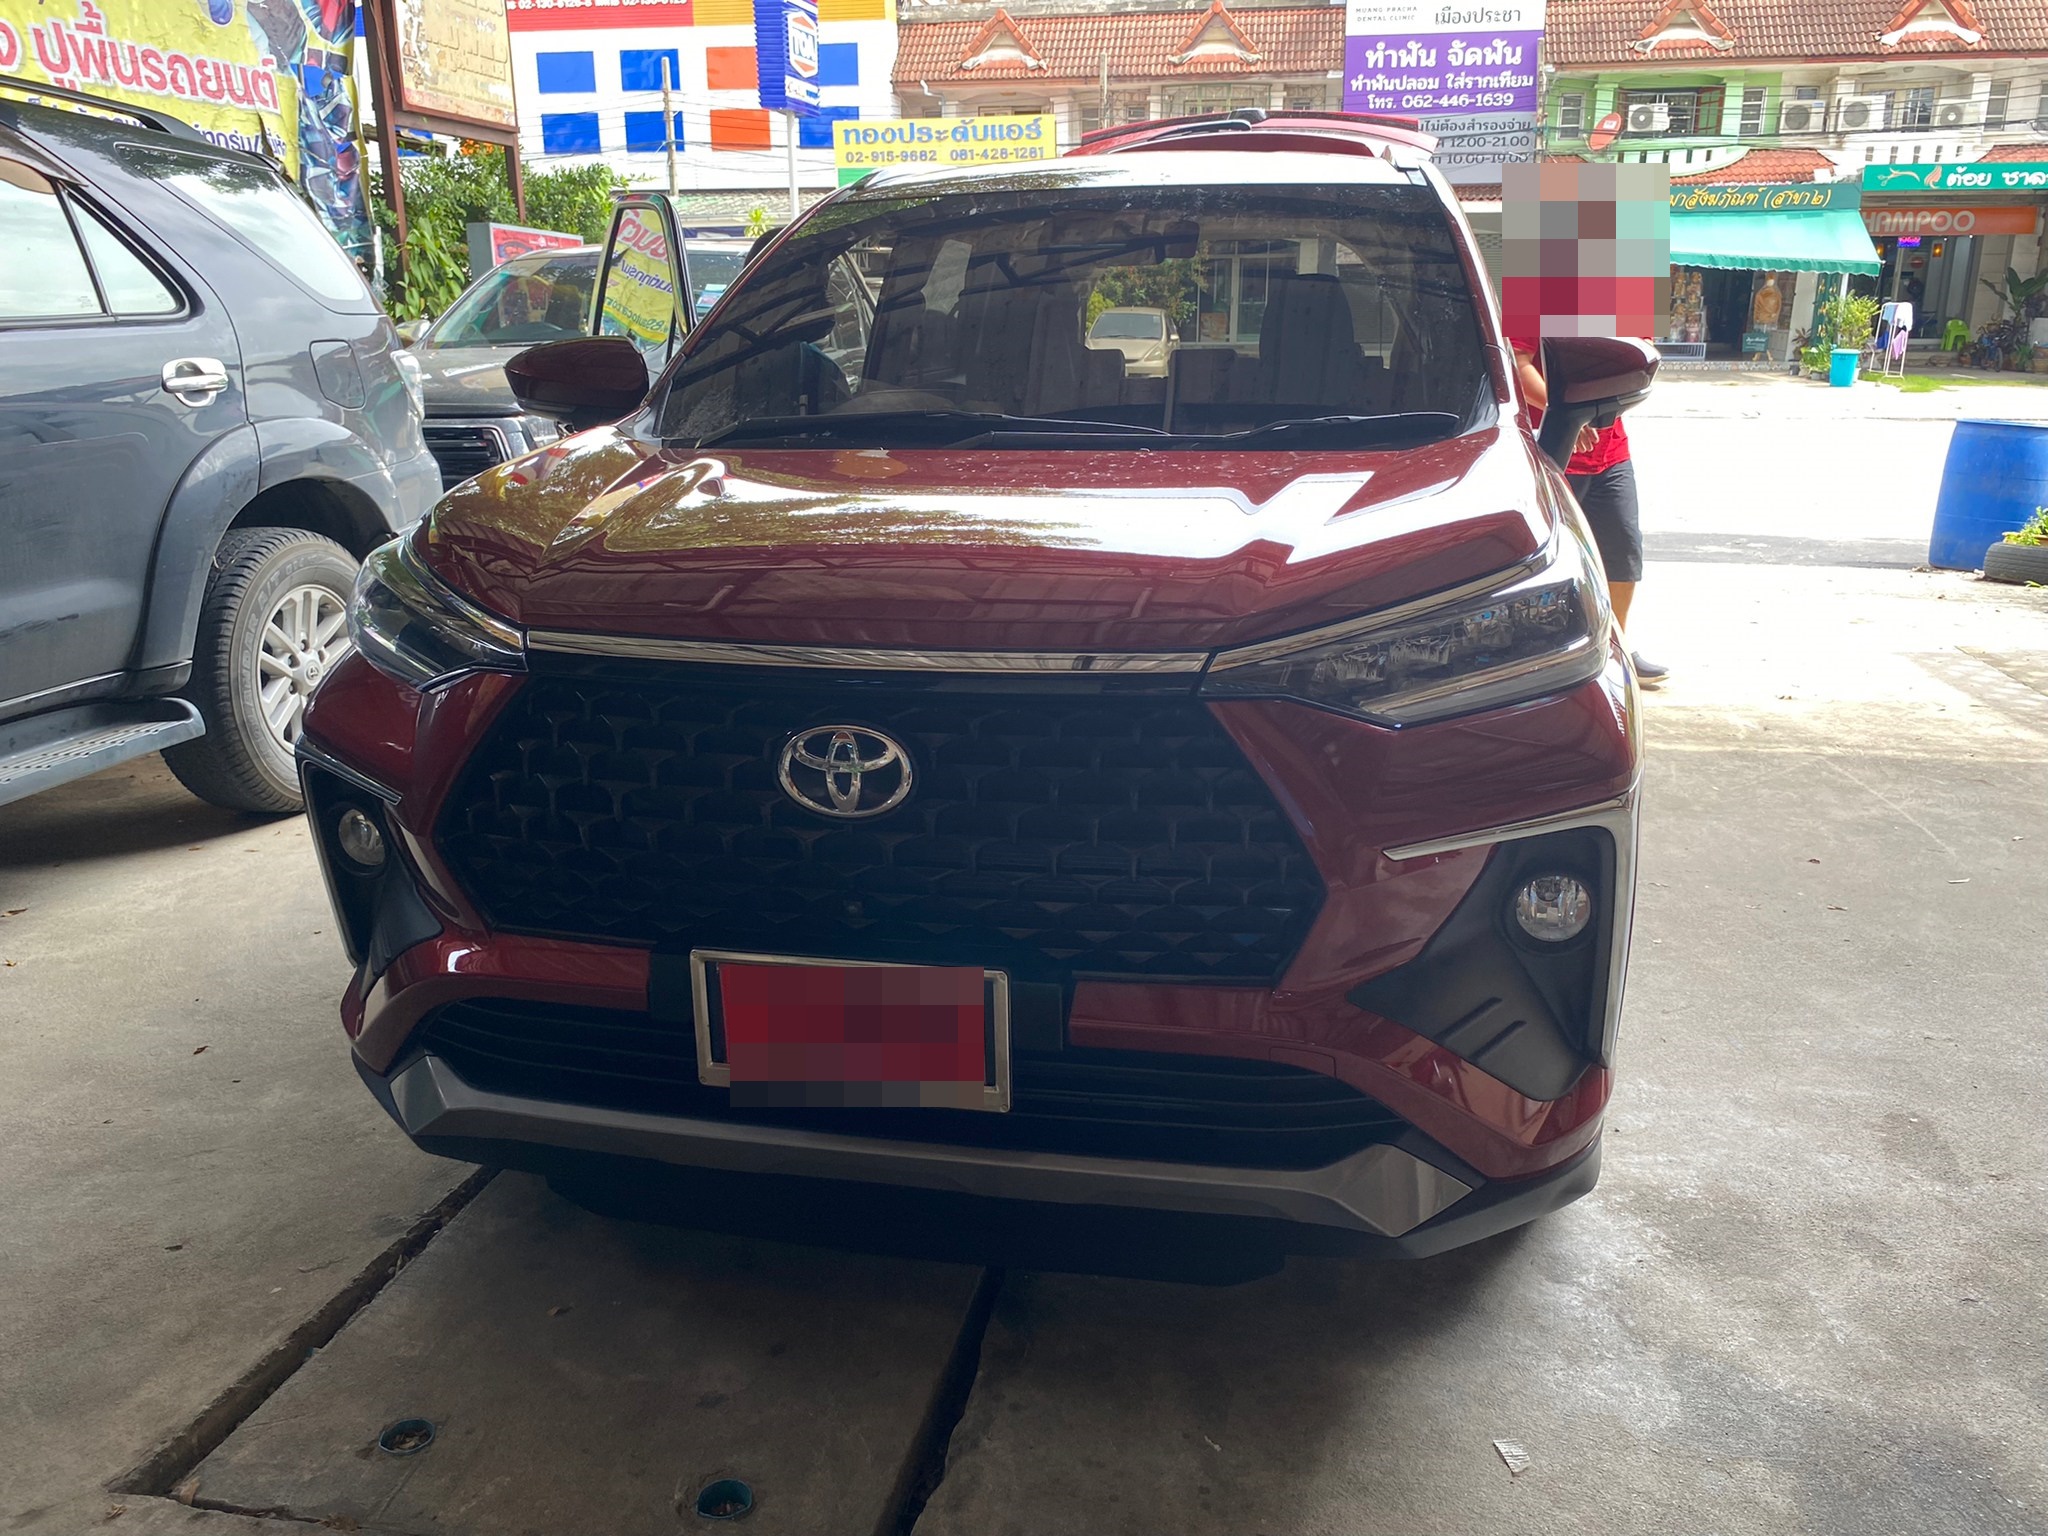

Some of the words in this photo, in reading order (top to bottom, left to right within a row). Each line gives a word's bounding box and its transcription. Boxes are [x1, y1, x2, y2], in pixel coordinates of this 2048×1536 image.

[1435, 6, 1521, 25] เมืองประชา
[32, 1, 279, 109] ปูพื้นรถยนต์
[1365, 41, 1437, 69] ทำฟัน
[1448, 38, 1522, 67] จัดฟัน
[1350, 73, 1439, 91] ทำฟันปลอม
[1445, 70, 1533, 89] ใส่รากเทียม
[1367, 94, 1397, 109] โทร.
[1402, 93, 1514, 108] 062-446-1639
[843, 117, 1044, 145] ทองประดับแอร์
[1451, 136, 1529, 148] 12.00-21.00
[845, 150, 937, 163] 02-915-9682
[950, 147, 1044, 161] 081-428-1281
[1946, 166, 1992, 187] ต้อย
[2002, 171, 2048, 186] ซาล
[1862, 210, 1976, 233] HAMPOO
